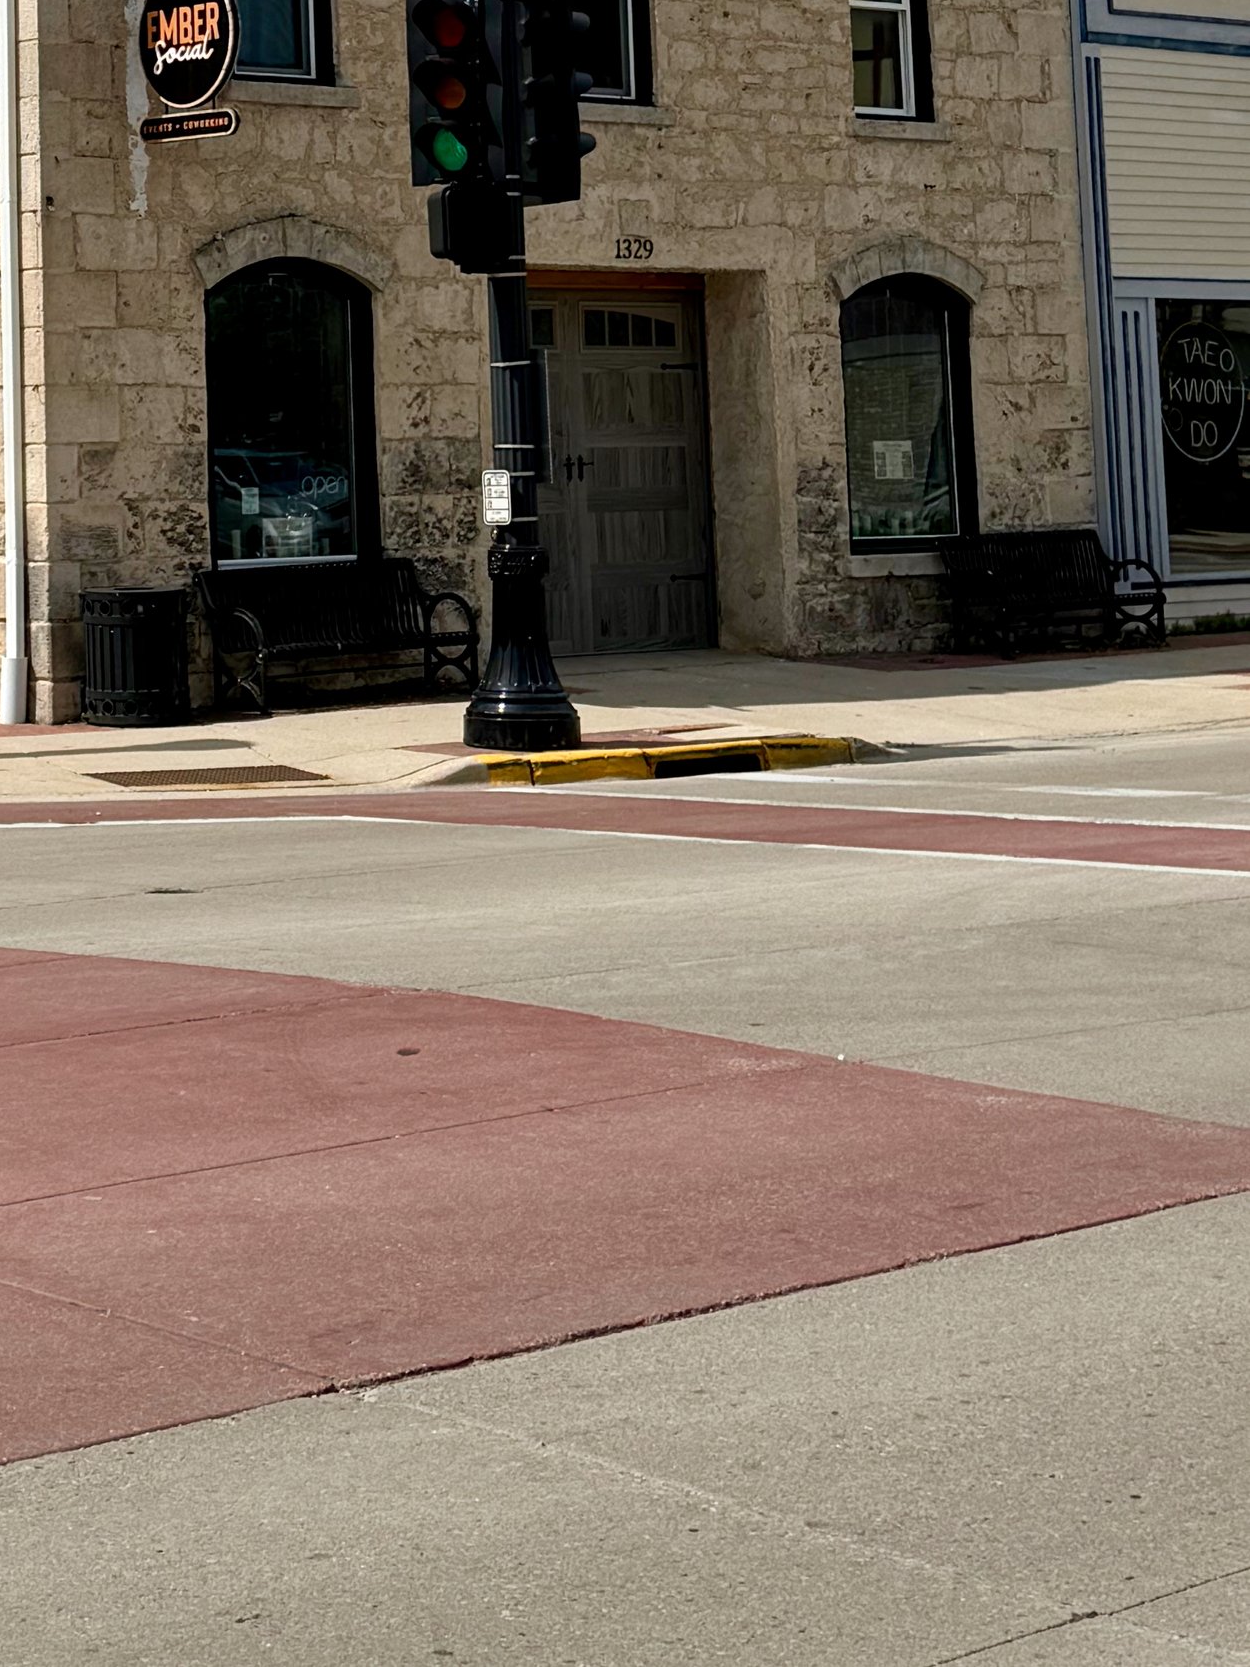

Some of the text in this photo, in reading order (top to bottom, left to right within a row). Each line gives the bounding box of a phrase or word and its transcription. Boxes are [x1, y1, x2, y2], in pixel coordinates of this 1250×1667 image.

[146, 1, 220, 50] EMBER
[153, 28, 214, 75] Social
[143, 116, 230, 134] EVENTS COWORKING
[614, 238, 654, 260] 1329
[1168, 377, 1232, 405] KWON
[1190, 420, 1219, 447] DO
[301, 475, 349, 501] open
